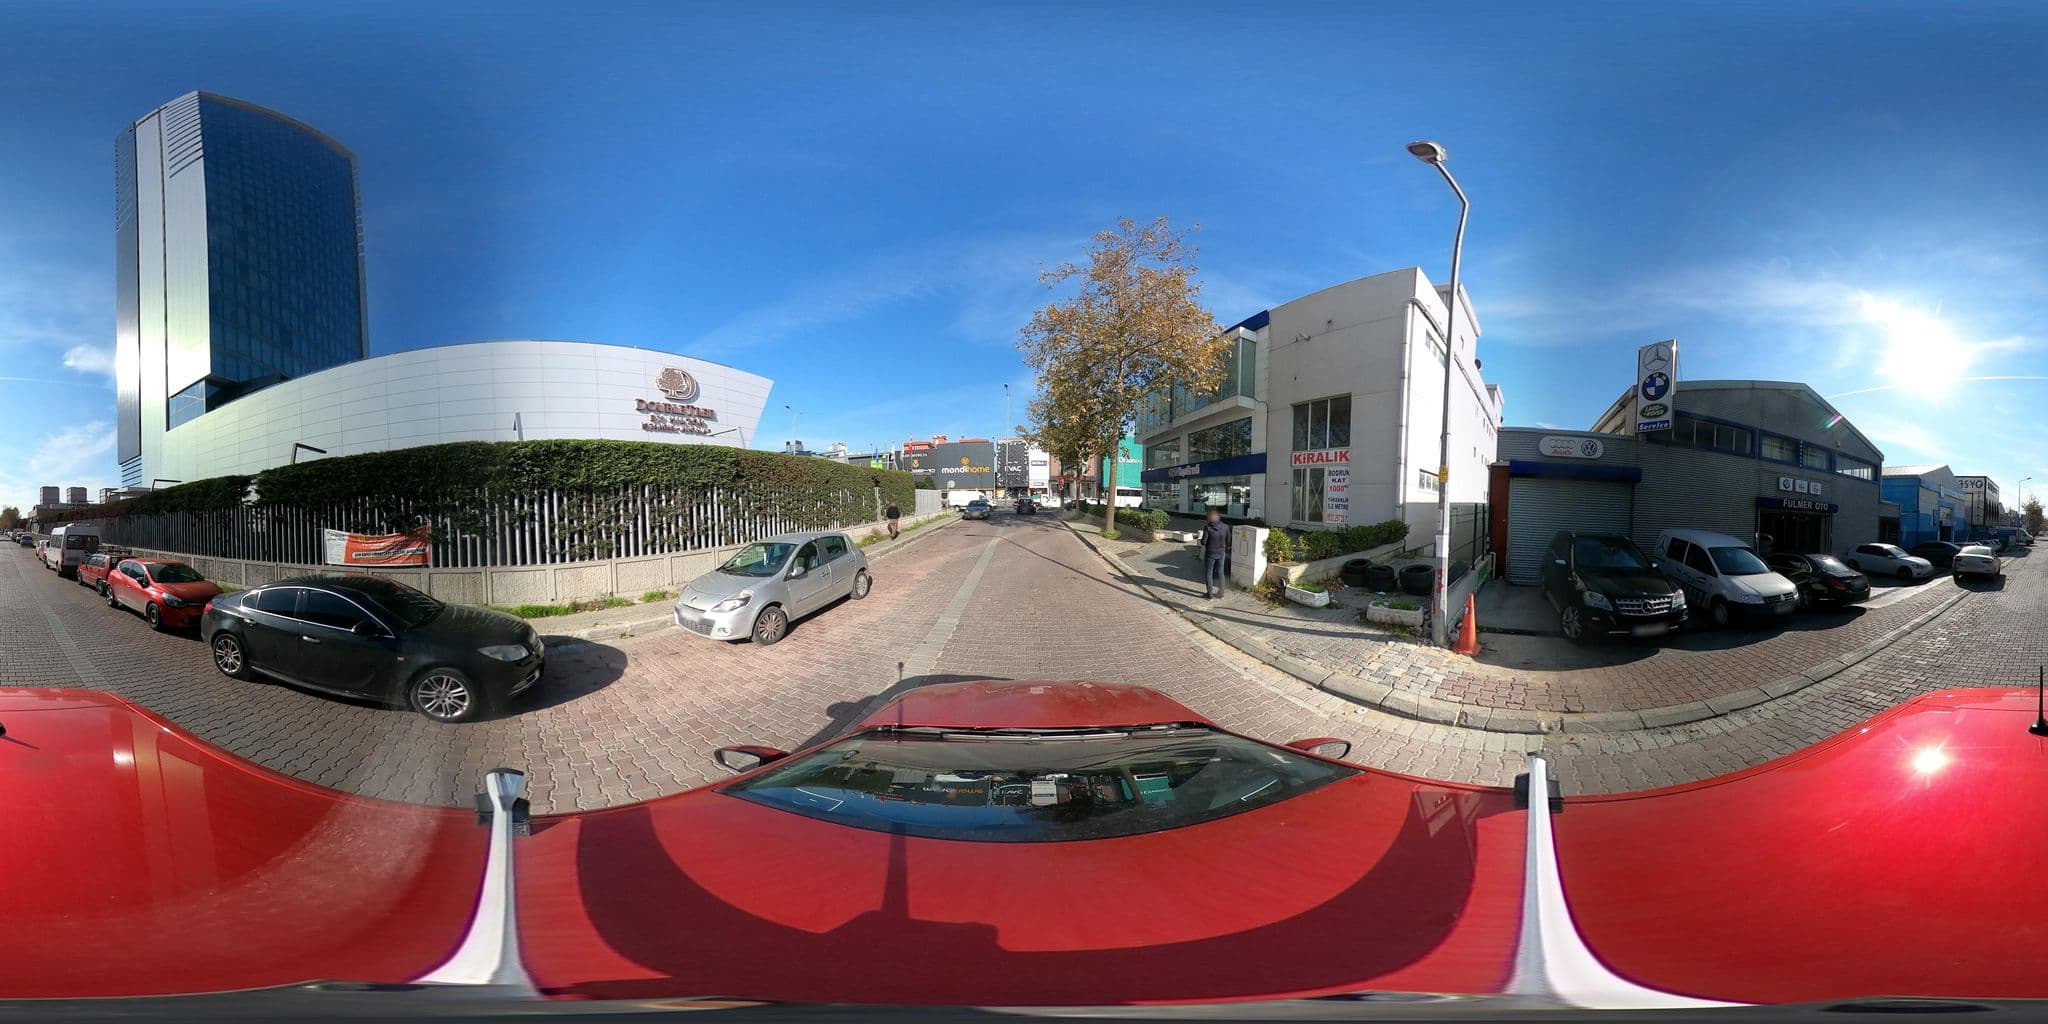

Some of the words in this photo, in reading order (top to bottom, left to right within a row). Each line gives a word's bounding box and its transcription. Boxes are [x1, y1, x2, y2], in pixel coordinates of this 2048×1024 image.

[1639, 421, 1669, 430] Service
[1552, 447, 1573, 456] Audi
[941, 465, 990, 474] mondihome
[1783, 499, 1813, 509] FULMER
[1815, 502, 1829, 510] OTO
